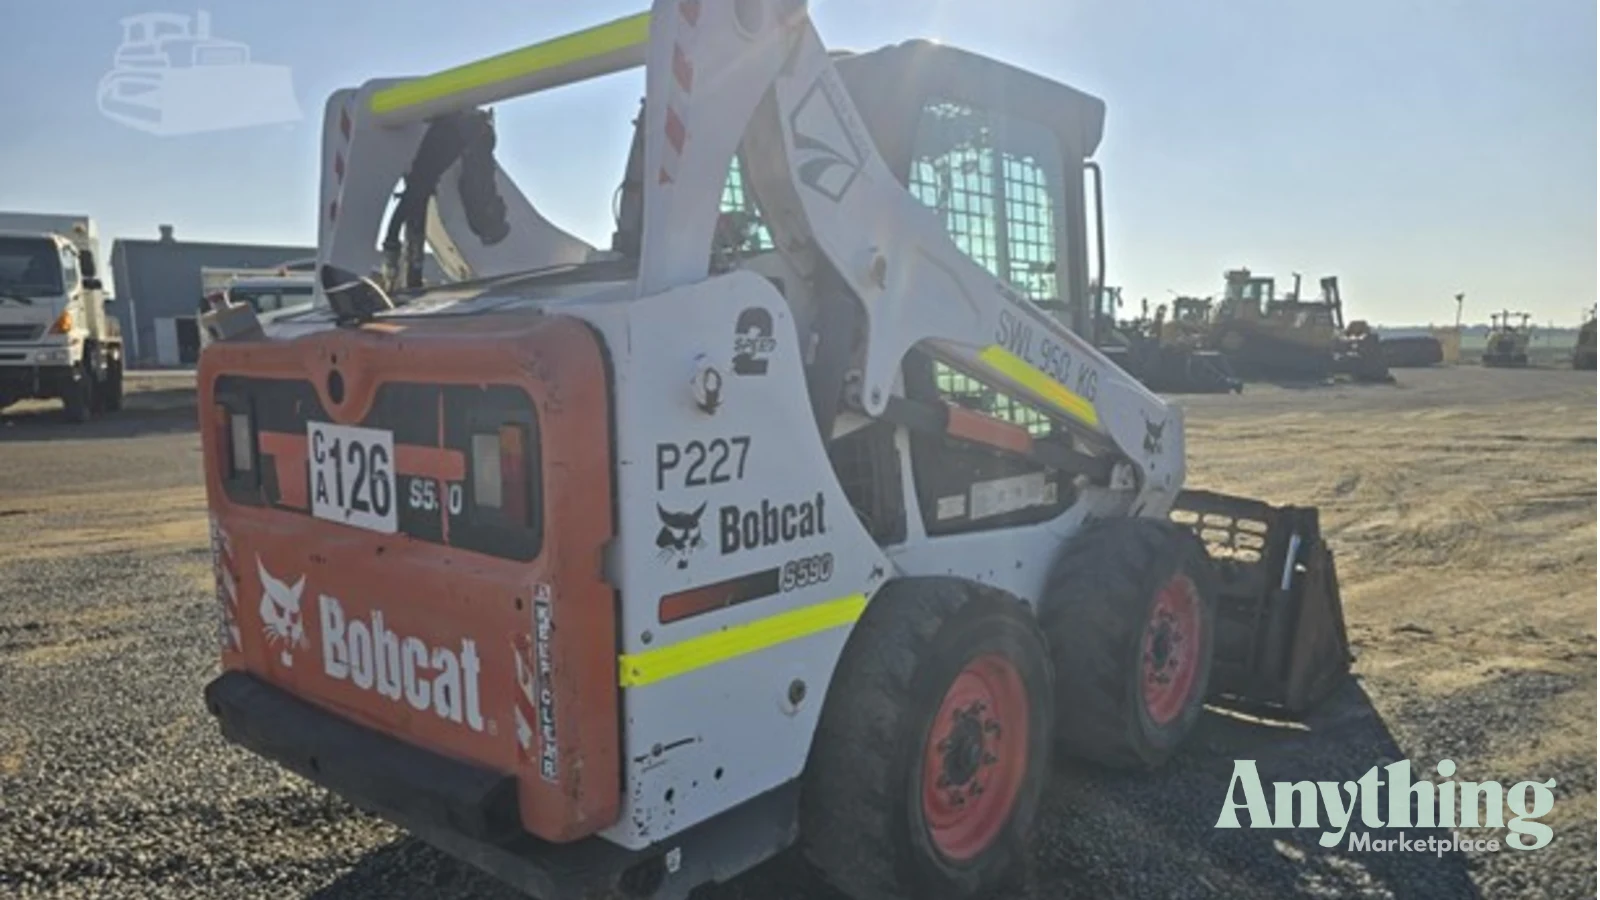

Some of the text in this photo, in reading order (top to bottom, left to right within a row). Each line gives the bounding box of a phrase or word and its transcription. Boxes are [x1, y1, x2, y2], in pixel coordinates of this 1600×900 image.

[995, 308, 1098, 402] SWL 950 KG
[329, 438, 391, 517] 126
[656, 436, 751, 491] P227
[410, 478, 462, 515] S50
[719, 492, 825, 556] Bobcat
[782, 552, 833, 592] S590
[319, 594, 484, 733] Bobcat
